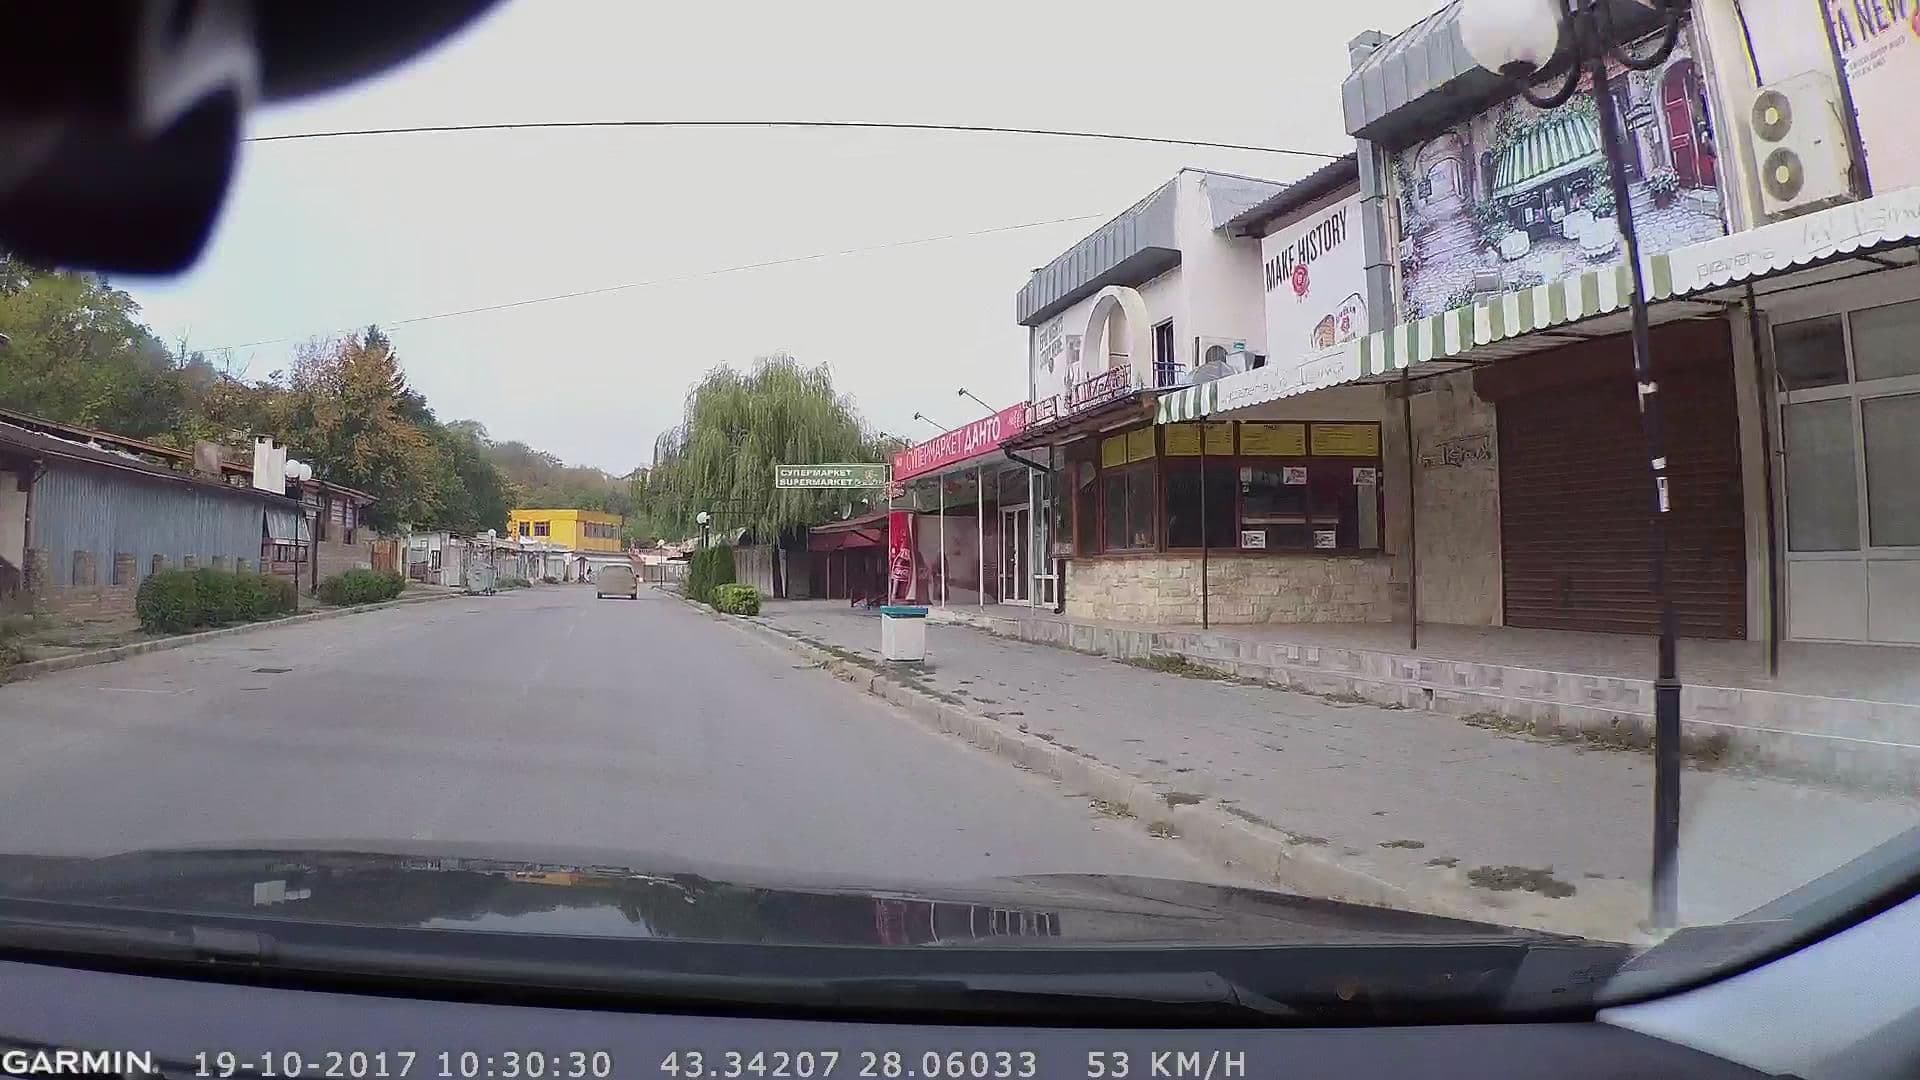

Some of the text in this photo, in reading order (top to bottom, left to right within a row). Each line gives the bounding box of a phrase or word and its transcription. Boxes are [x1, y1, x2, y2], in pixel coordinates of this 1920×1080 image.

[1265, 206, 1348, 293] MAKE HISTORY
[905, 416, 1001, 471] СУПЕРМАРКЕТ ДАНТО
[779, 478, 852, 487] SUPERMARKET
[780, 469, 852, 477] СУПЕРМАРКЕТ
